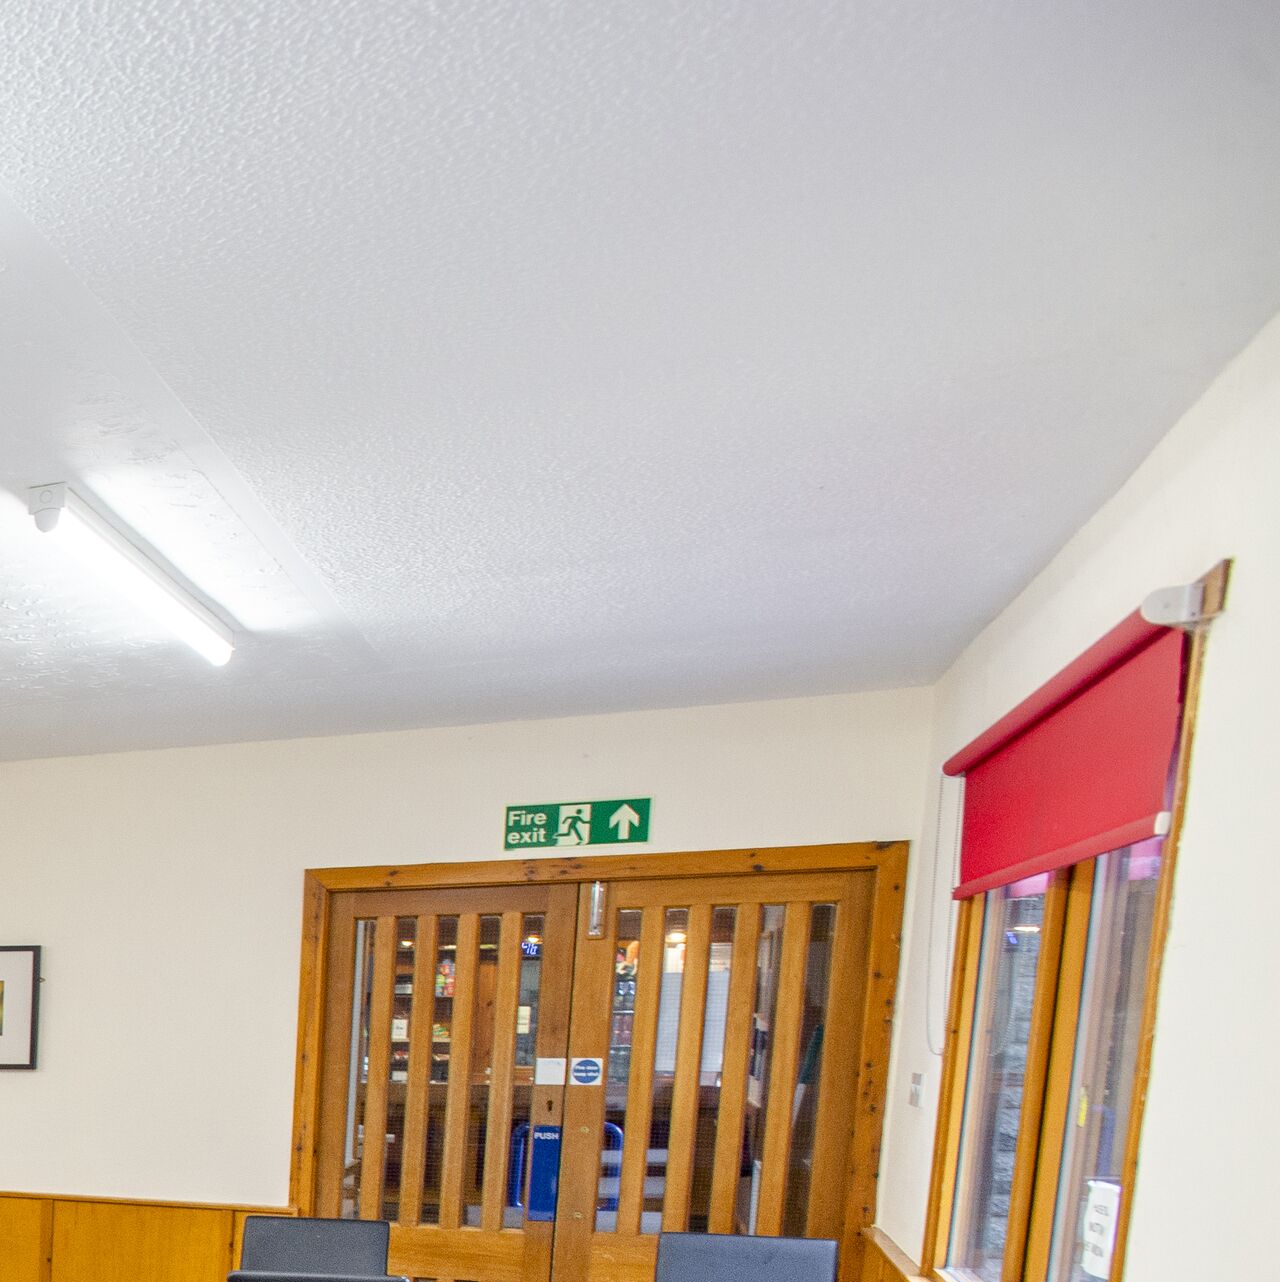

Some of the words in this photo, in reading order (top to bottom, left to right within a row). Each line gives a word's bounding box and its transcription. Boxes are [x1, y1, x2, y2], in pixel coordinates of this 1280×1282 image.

[508, 810, 547, 826] Fire
[507, 827, 547, 845] exit
[534, 1132, 559, 1140] PUSH
